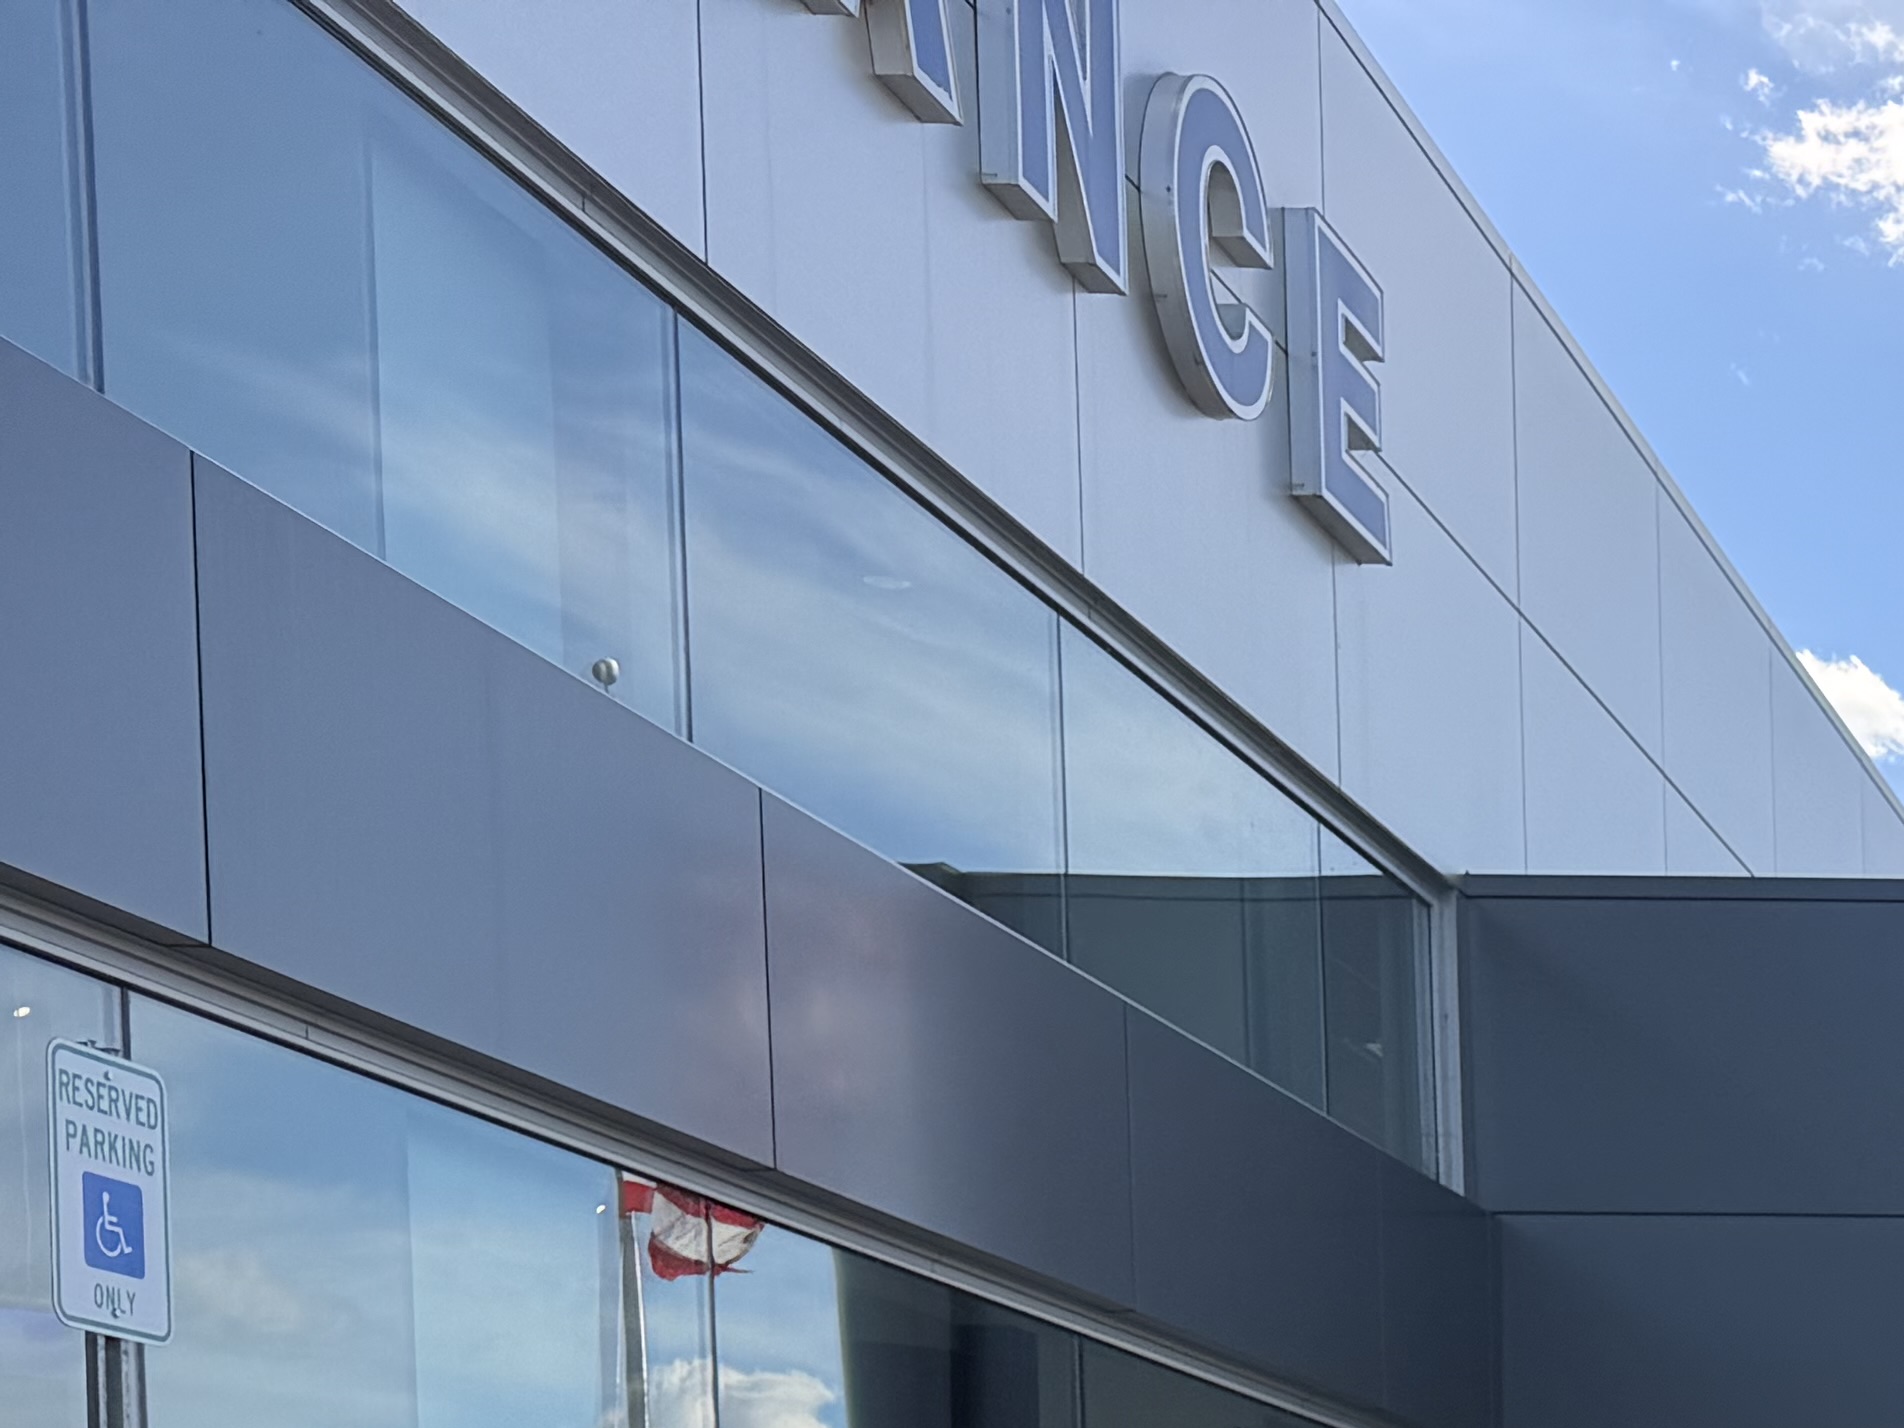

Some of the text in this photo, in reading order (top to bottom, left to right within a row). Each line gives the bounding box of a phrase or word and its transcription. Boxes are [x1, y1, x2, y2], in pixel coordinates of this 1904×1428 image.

[57, 1067, 159, 1131] RESERVED
[64, 1119, 156, 1177] PARKING
[93, 1282, 137, 1317] ONLY
